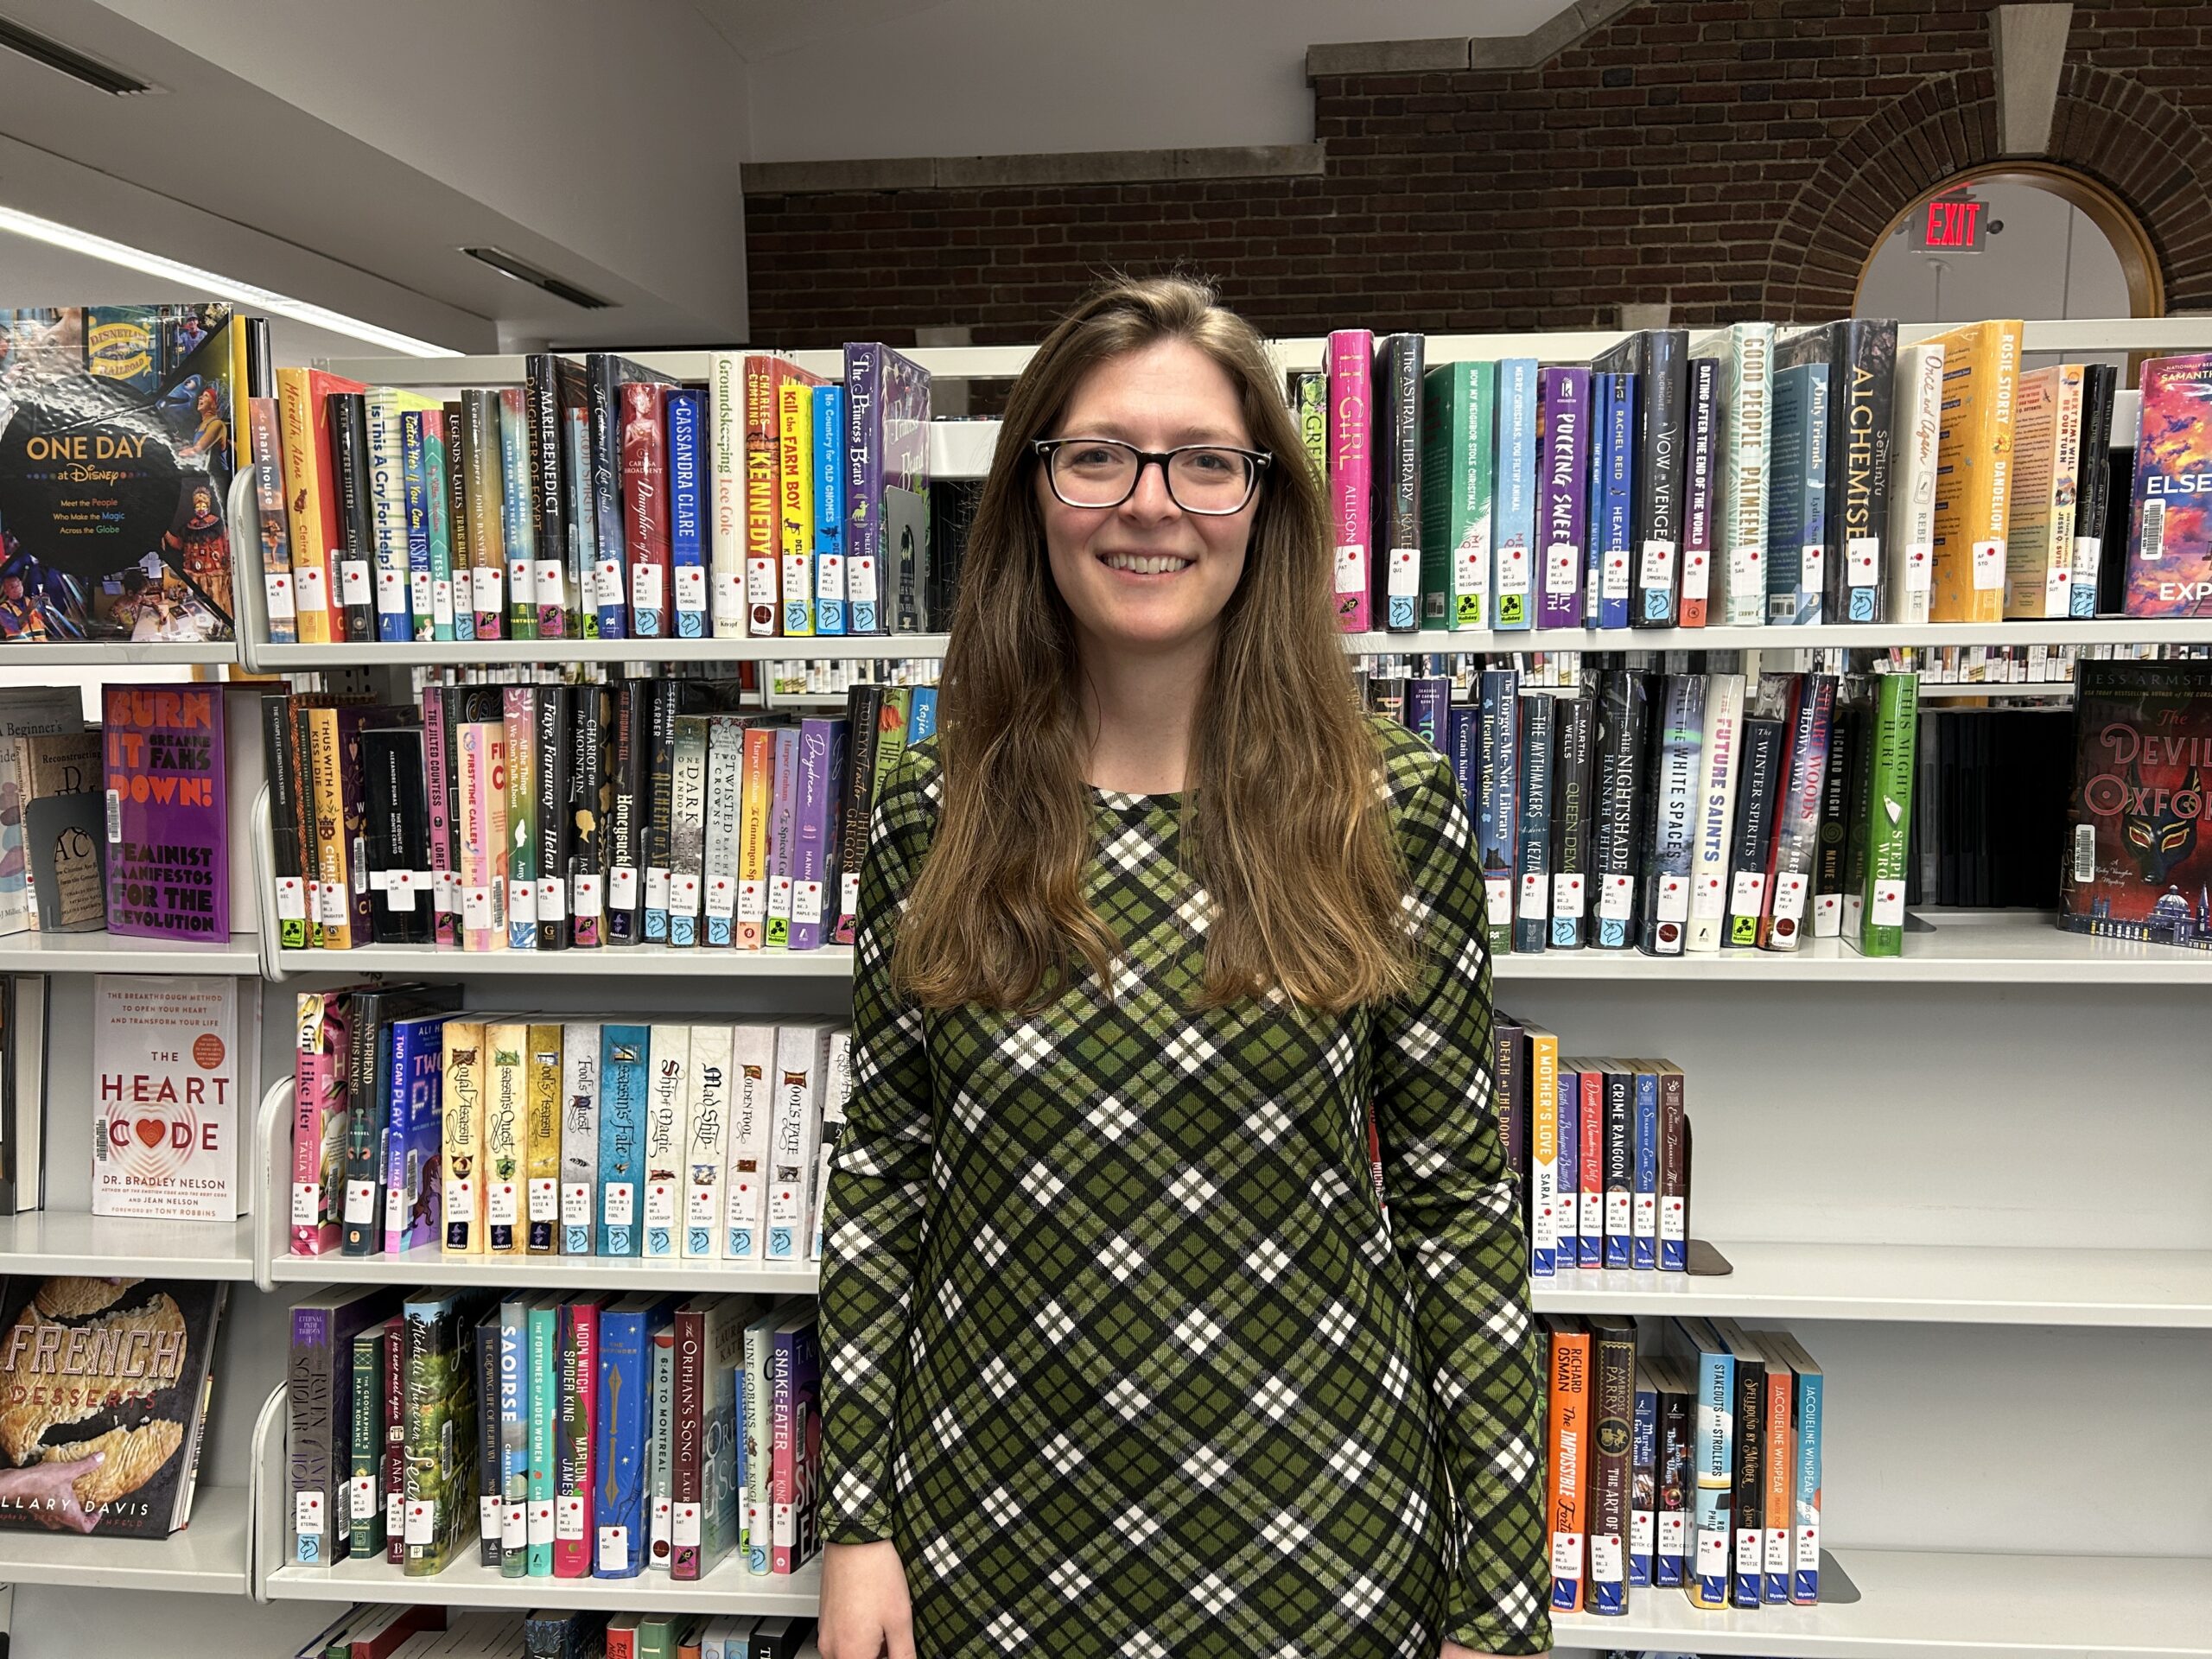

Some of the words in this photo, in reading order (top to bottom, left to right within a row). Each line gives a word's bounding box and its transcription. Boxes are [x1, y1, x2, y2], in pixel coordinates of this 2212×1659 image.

[1926, 203, 1980, 245] EXIT
[99, 359, 144, 376] RAILROAD
[853, 353, 874, 381] The
[1339, 354, 1363, 385] IT
[1403, 349, 1414, 372] The
[1743, 339, 1764, 387] GOOD
[2001, 335, 2014, 372] ROSIE
[372, 405, 380, 418] Is
[541, 391, 554, 439] MARIE
[718, 359, 733, 474] Groundskeeping
[749, 373, 759, 426] CUMMING
[759, 373, 771, 426] CHARLES
[784, 391, 798, 414] Kill
[825, 394, 834, 407] No
[850, 388, 870, 444] Princess
[1402, 376, 1414, 433] ASTRAL
[1741, 391, 1762, 448] PEOPLE
[1997, 377, 2012, 424] STOREY
[27, 436, 87, 461] ONE
[97, 435, 147, 459] DAY
[258, 425, 270, 461] shark
[372, 423, 384, 452] This
[677, 408, 691, 489] CASSANDRA
[825, 410, 834, 447] Country
[1339, 396, 1363, 470] GIRL
[373, 455, 385, 467] A
[785, 435, 798, 475] FARM
[825, 465, 834, 485] OLD
[850, 447, 869, 486] Beard
[1402, 438, 1414, 501] LIBRARY
[1874, 431, 1886, 497] SenLinYu
[58, 472, 67, 480] at
[262, 466, 273, 505] house
[374, 471, 387, 499] Cry
[544, 442, 558, 516] BENEDICT
[720, 479, 733, 503] Lee
[786, 478, 800, 511] BOY
[2147, 474, 2212, 494] ELSE
[92, 499, 118, 508] People
[102, 512, 124, 521] Magic
[377, 502, 389, 526] For
[678, 490, 695, 537] CLARE
[749, 450, 771, 554] KENNEDY
[825, 486, 834, 524] GNOMES
[1345, 486, 1357, 543] ALLISON
[1739, 467, 1761, 545] PATMEENA
[1991, 461, 2005, 534] DANDELION
[96, 525, 119, 534] Globe
[721, 504, 734, 536] Cole
[107, 692, 211, 729] BURN
[544, 702, 556, 742] Faye,
[1532, 715, 1545, 736] THE
[109, 733, 144, 768] IT
[149, 735, 211, 747] BREANNE
[587, 720, 596, 772] CHARIOT
[1483, 715, 1495, 760] Heather
[1498, 696, 1513, 789] Forget-Me-Not
[1711, 718, 1732, 789] FUTURE
[2101, 723, 2212, 767] DEVIL
[149, 748, 211, 770] FAHS
[544, 745, 555, 810] Faraway
[575, 728, 584, 793] MOUNTAIN
[803, 734, 824, 807] Daydream
[1670, 748, 1688, 794] WHITE
[108, 774, 212, 806] DOWN!
[588, 775, 594, 785] on
[685, 768, 699, 823] DARK
[713, 767, 721, 826] CROWNS
[724, 762, 734, 833] TWISTED
[1482, 763, 1494, 808] Webber
[1529, 742, 1546, 818] MYTHMAKERS
[1496, 792, 1511, 841] Library
[1612, 755, 1633, 870] NIGHTSHADE
[1667, 802, 1684, 858] SPACES
[1704, 795, 1725, 862] SAINTS
[111, 843, 212, 867] FEMINIST
[545, 830, 556, 870] Helen
[111, 867, 213, 884] MANIFESTOS
[111, 884, 158, 906] FOR
[164, 887, 213, 912] THE
[114, 911, 214, 932] REVOLUTION
[151, 1052, 179, 1062] THE
[101, 1074, 229, 1105] HEART
[1540, 1057, 1552, 1120] MOTHER'S
[1613, 1084, 1625, 1120] CRIME
[1540, 1123, 1551, 1155] LOVE
[1611, 1125, 1625, 1178] RANGOON
[104, 1175, 121, 1185] DR.
[125, 1176, 175, 1188] BRADLEY
[180, 1178, 226, 1190] NELSON
[1541, 1173, 1549, 1199] SARA
[5, 1325, 183, 1378] FRENCH
[576, 1323, 589, 1356] MOON
[501, 1325, 517, 1421] SAOIRSE
[563, 1351, 575, 1391] SPIDER
[576, 1361, 588, 1393] WITCH
[682, 1340, 697, 1415] ORPHAN'S
[1558, 1347, 1569, 1391] OSMAN
[1572, 1348, 1582, 1393] RICHARD
[1714, 1363, 1724, 1413] STAKEOUTS
[11, 1385, 156, 1409] DESSERTS
[563, 1393, 575, 1422] KING
[660, 1389, 667, 1403] TO
[774, 1349, 788, 1451] SNAKE-EATER
[1606, 1366, 1618, 1414] PARRY
[1563, 1407, 1575, 1427] The
[1774, 1385, 1785, 1446] JACQUELINE
[575, 1436, 587, 1482] MARLON
[682, 1420, 696, 1462] SONG
[1713, 1429, 1723, 1477] STROLLERS
[562, 1459, 573, 1496] JAMES
[1558, 1429, 1577, 1498] IMPOSSIBLE
[1773, 1448, 1783, 1494] WINSPEAR
[85, 1501, 149, 1515] DAVIS
[1555, 1599, 1573, 1608] Mystery
